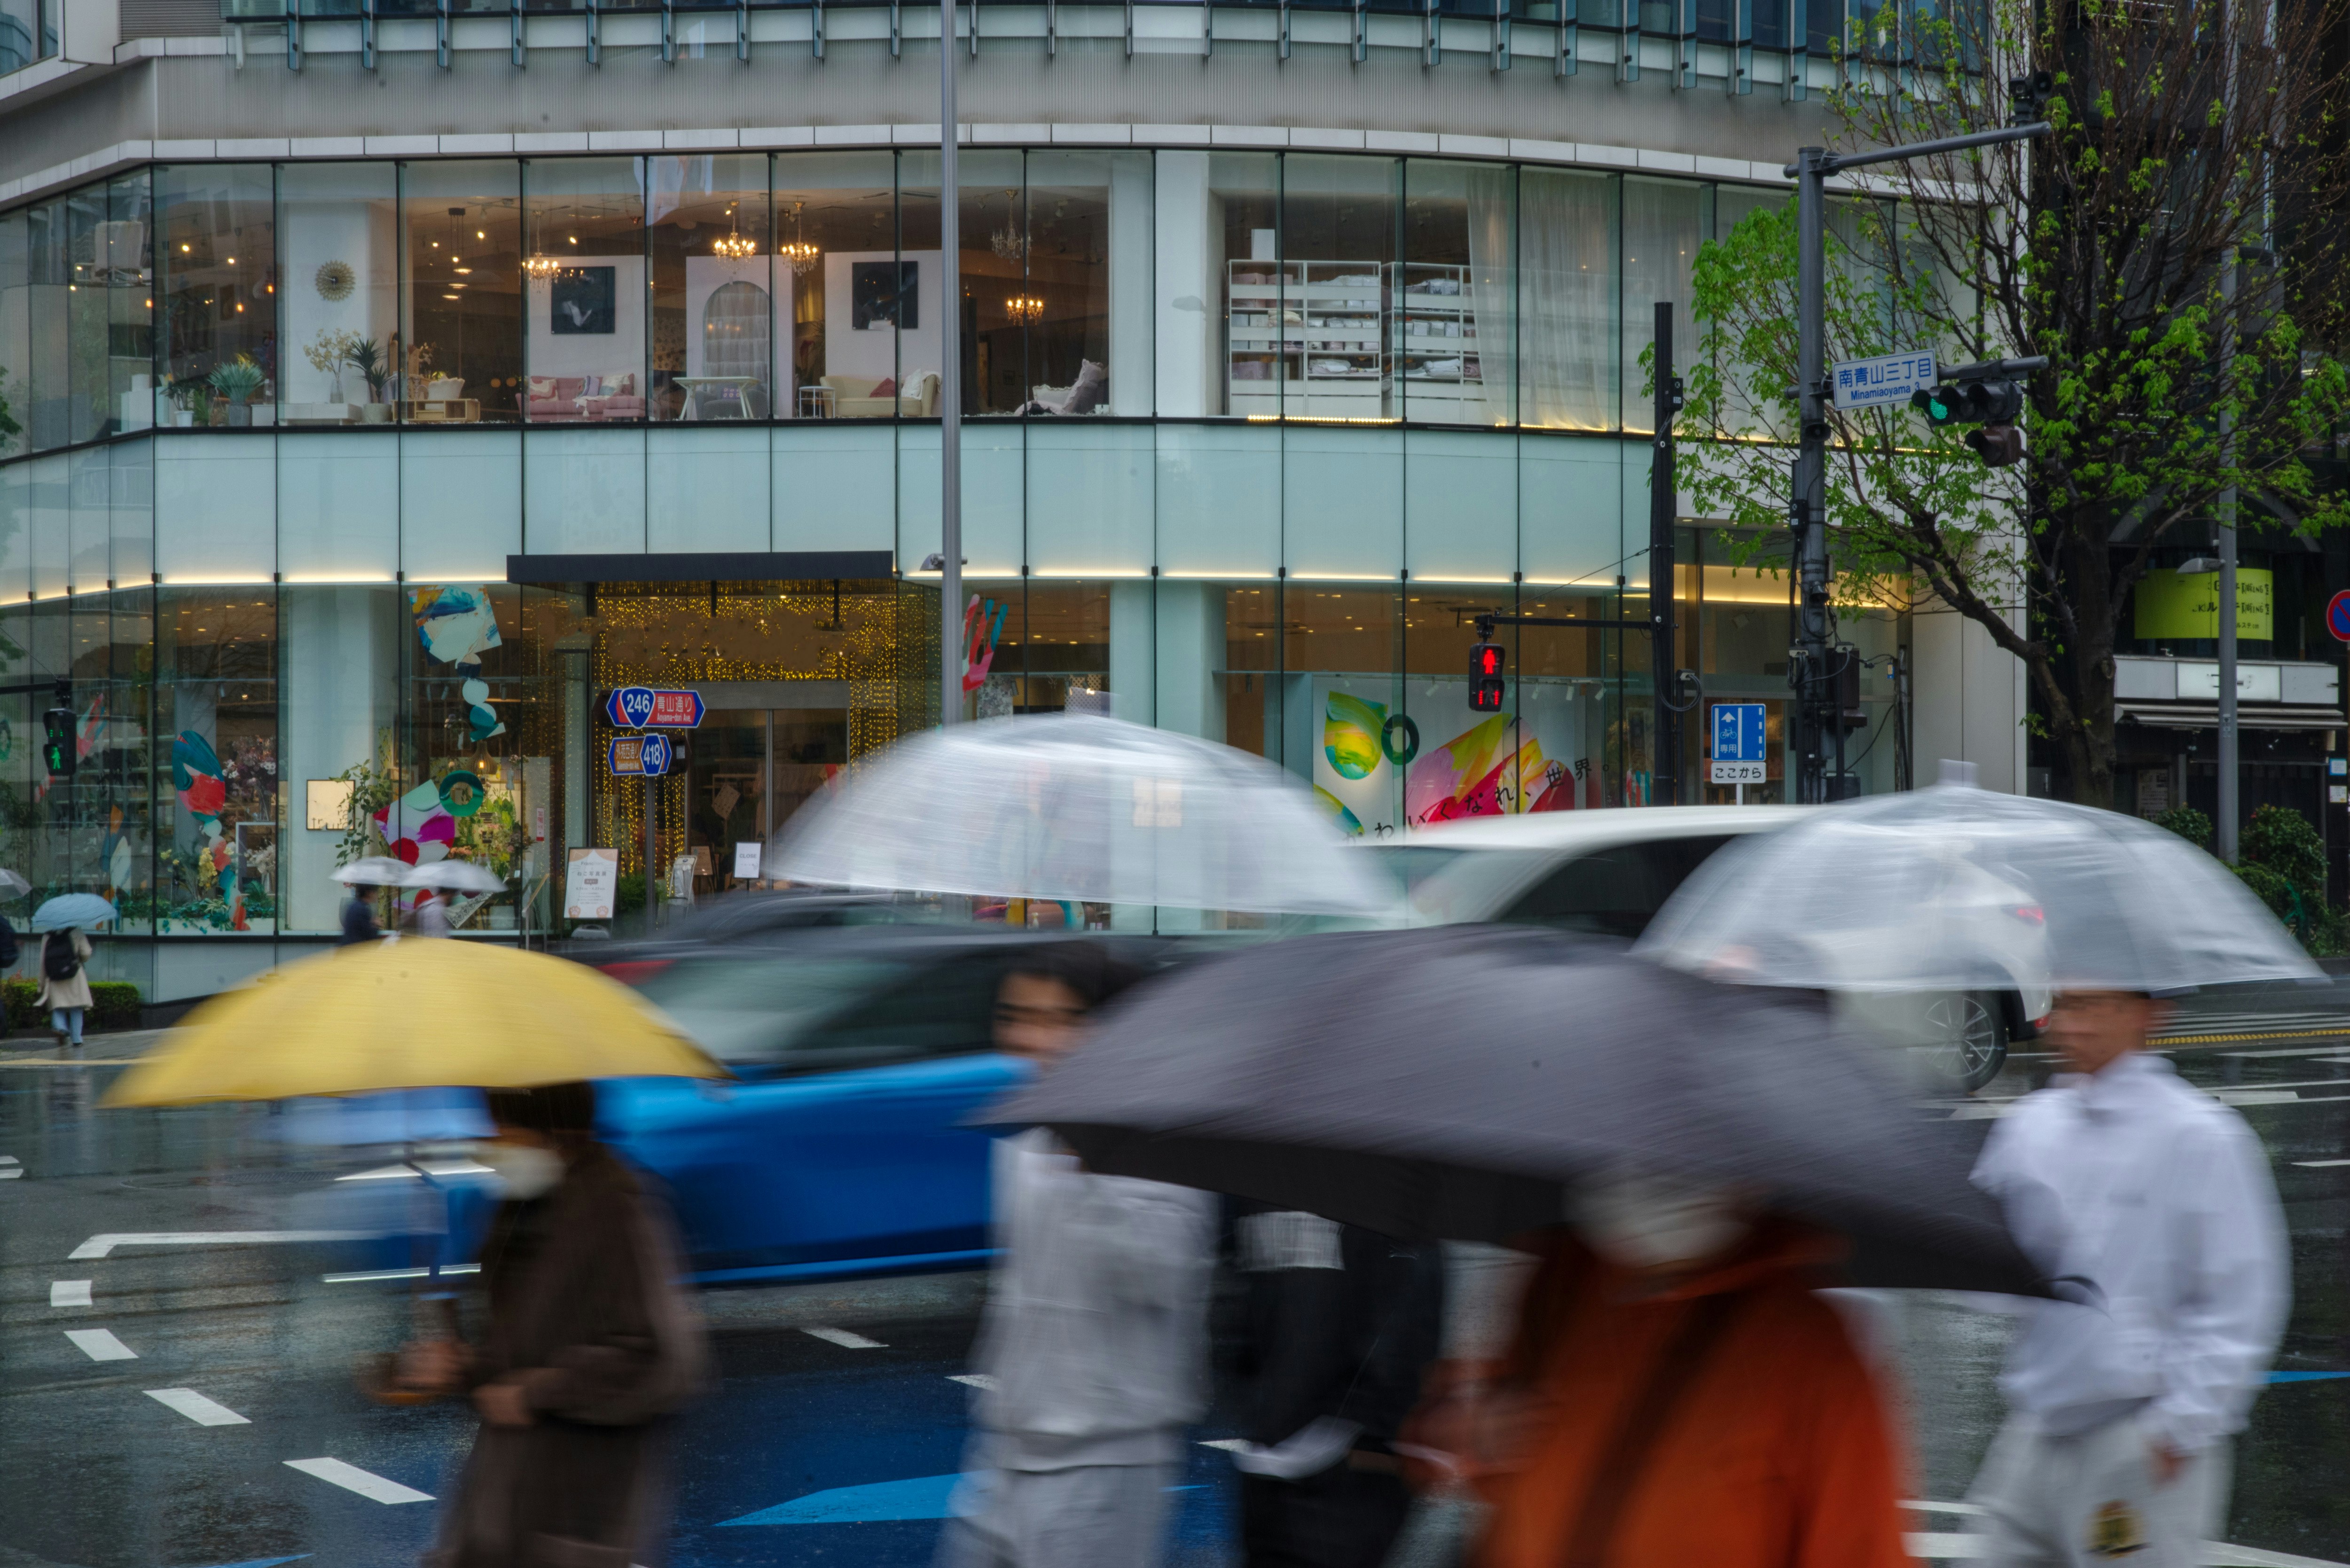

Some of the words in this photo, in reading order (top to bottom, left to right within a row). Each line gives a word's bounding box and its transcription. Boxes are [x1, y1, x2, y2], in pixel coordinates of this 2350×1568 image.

[1838, 358, 1931, 389] 南青山三丁目
[1850, 385, 1911, 401] Minamiaoyama
[1915, 382, 1920, 391] 3
[627, 694, 650, 713] 246
[657, 696, 692, 712] 青山通り
[657, 713, 682, 723] Aoyama-dori
[643, 744, 660, 765] 418
[1720, 744, 1737, 754] 専用
[1716, 767, 1762, 779] ここから
